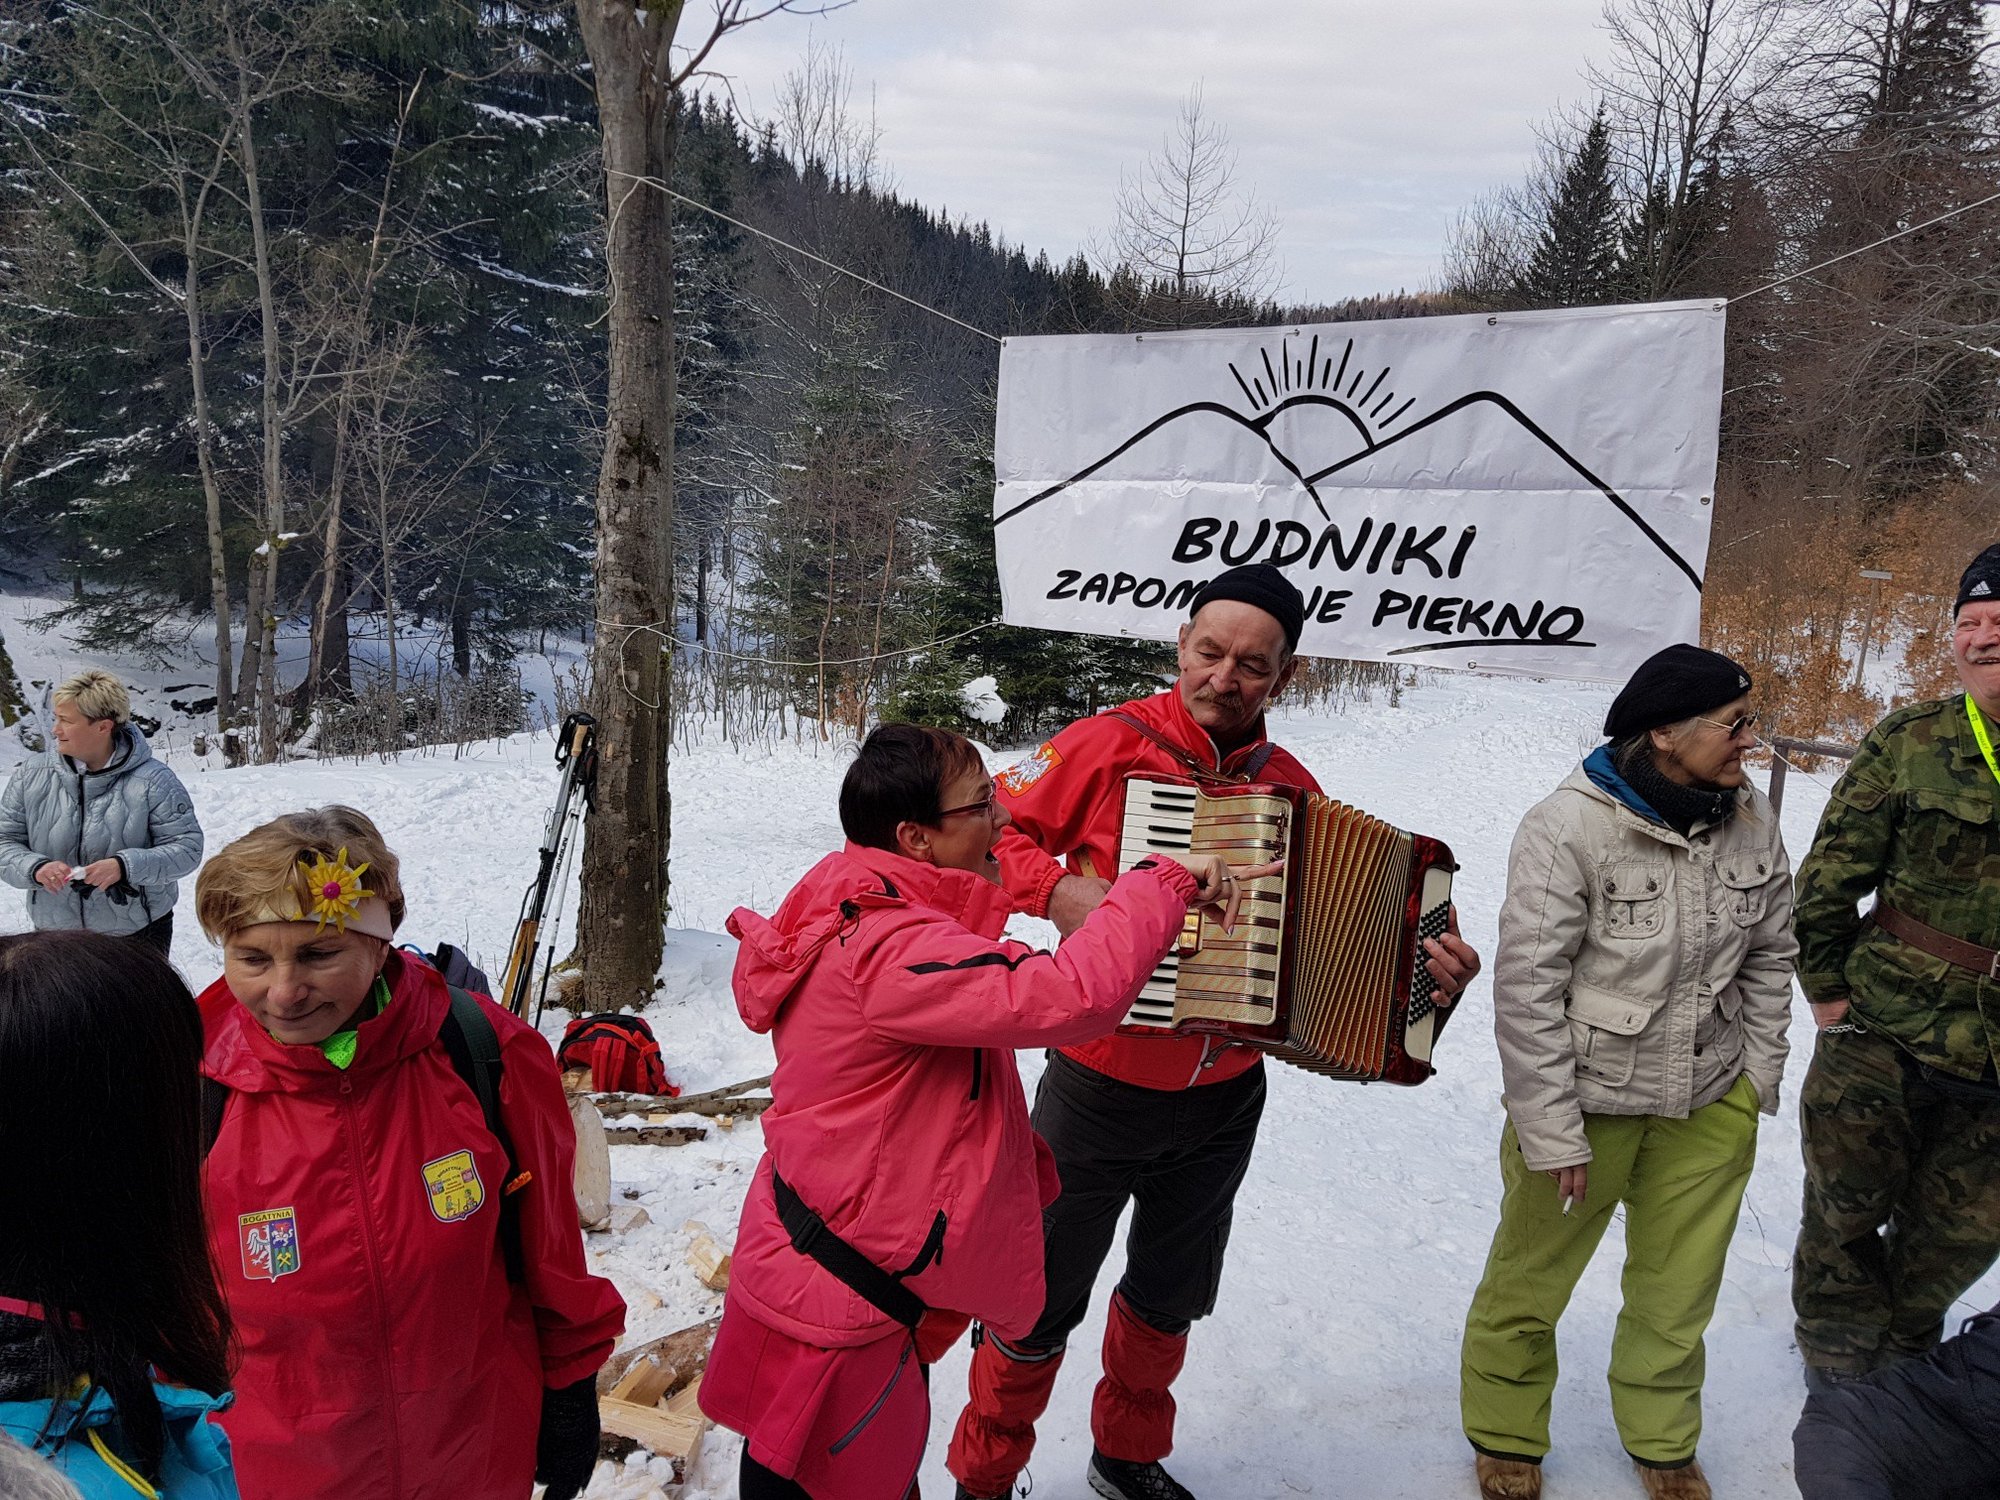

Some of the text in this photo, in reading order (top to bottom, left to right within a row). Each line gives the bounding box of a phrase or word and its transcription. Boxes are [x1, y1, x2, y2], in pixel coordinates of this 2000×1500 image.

[1171, 516, 1477, 579] BUDNIKI
[1046, 569, 1585, 641] ZAPOMNE PIĘKNO
[242, 1210, 291, 1224] BOGATYNIA
